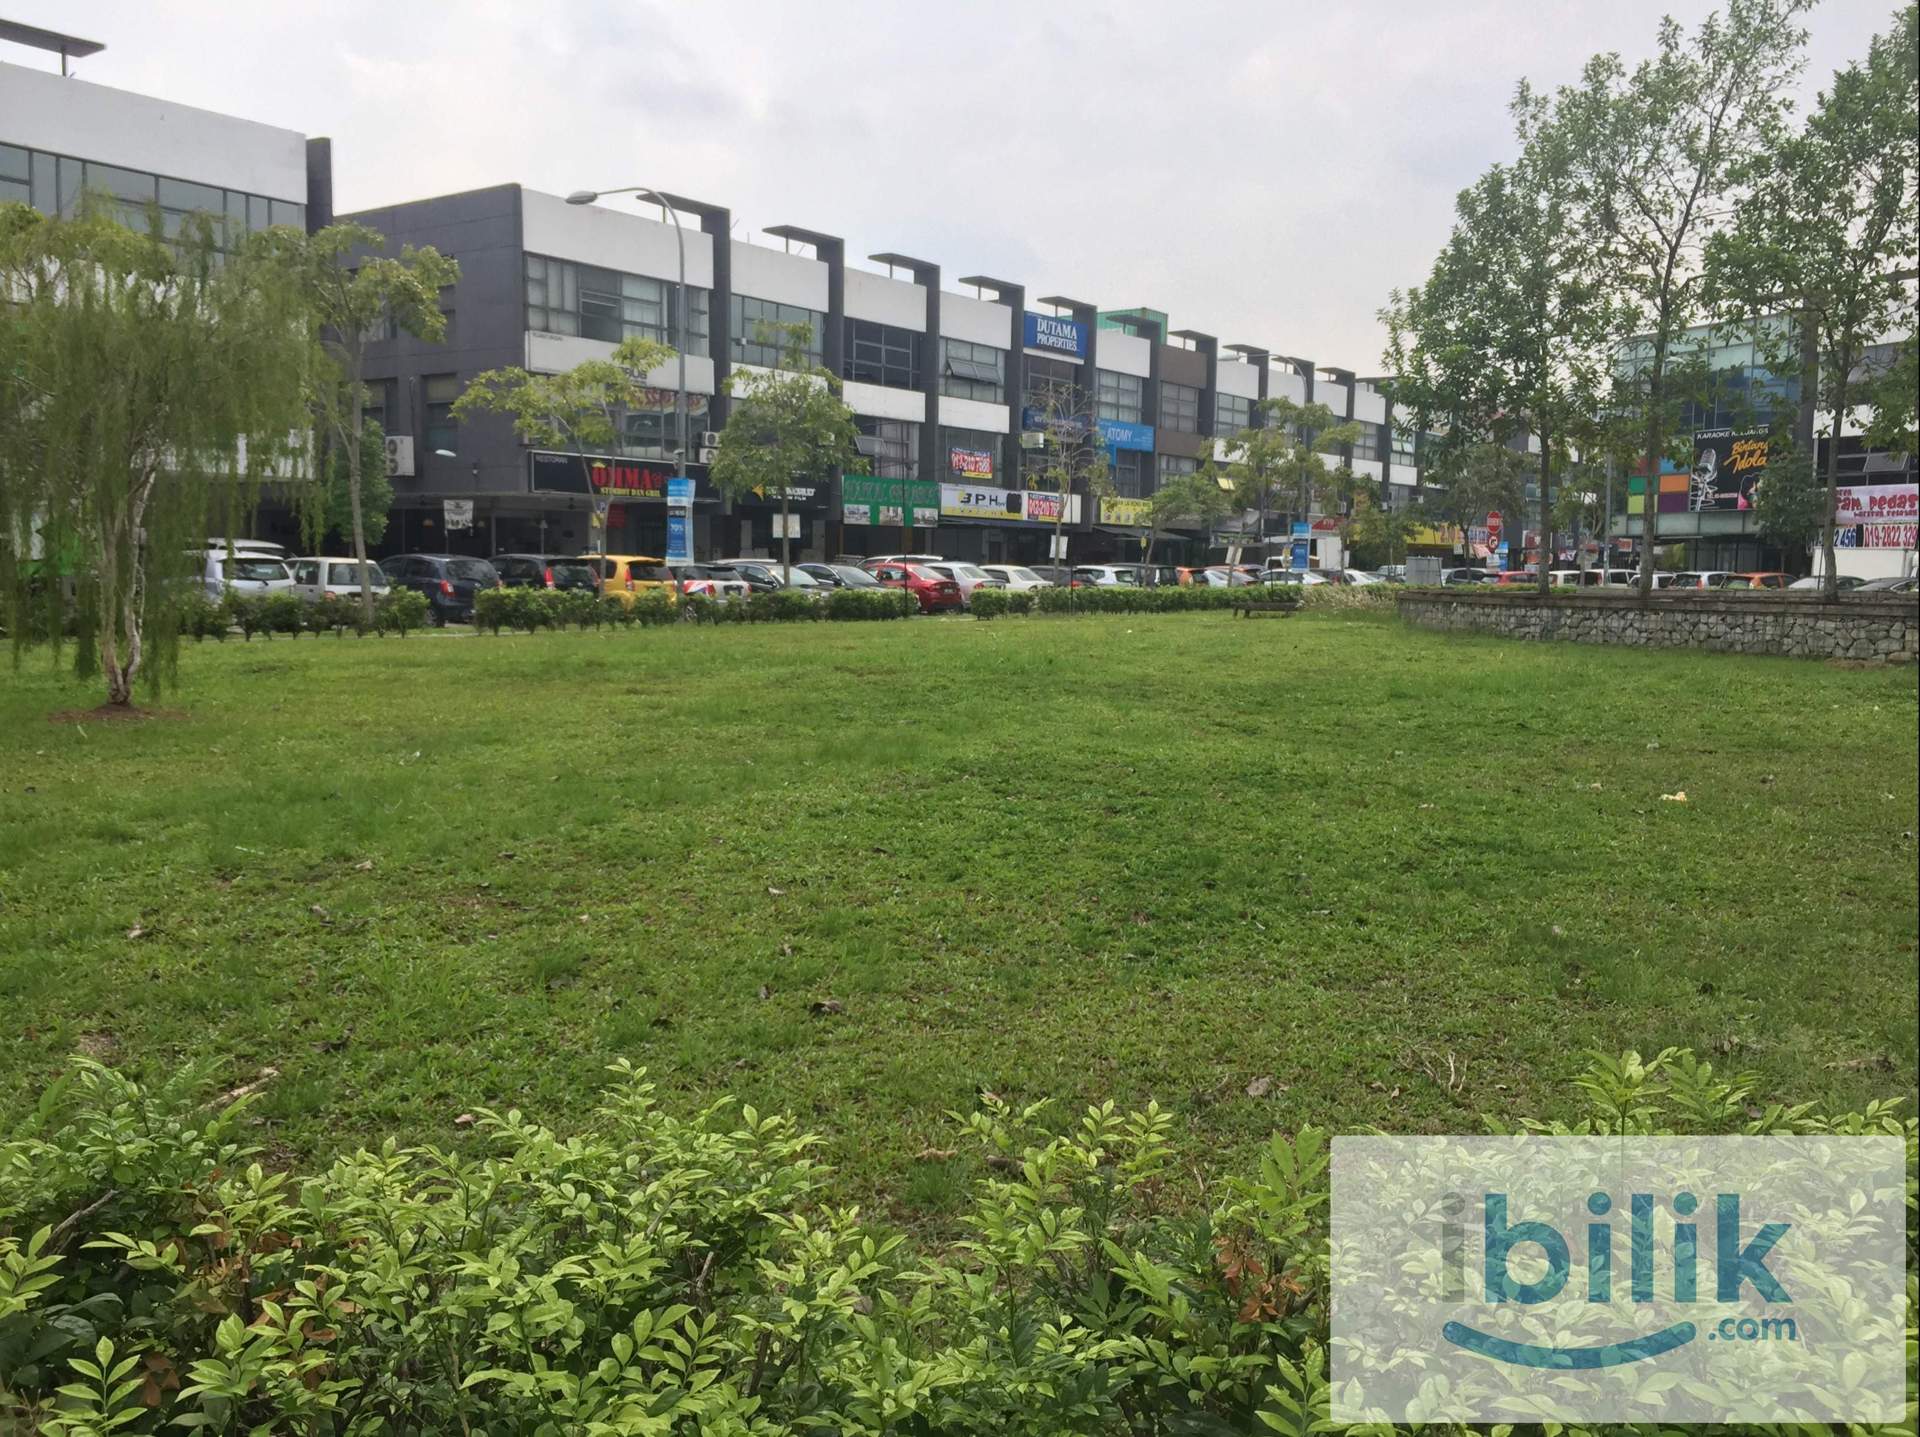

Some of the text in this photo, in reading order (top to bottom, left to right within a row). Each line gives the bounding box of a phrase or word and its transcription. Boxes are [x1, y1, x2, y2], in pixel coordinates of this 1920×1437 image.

[1037, 318, 1077, 340] DUTAMA
[1036, 332, 1077, 351] PROPERTIES
[1107, 427, 1132, 441] ATOMY
[1697, 431, 1730, 440] KARAOKE
